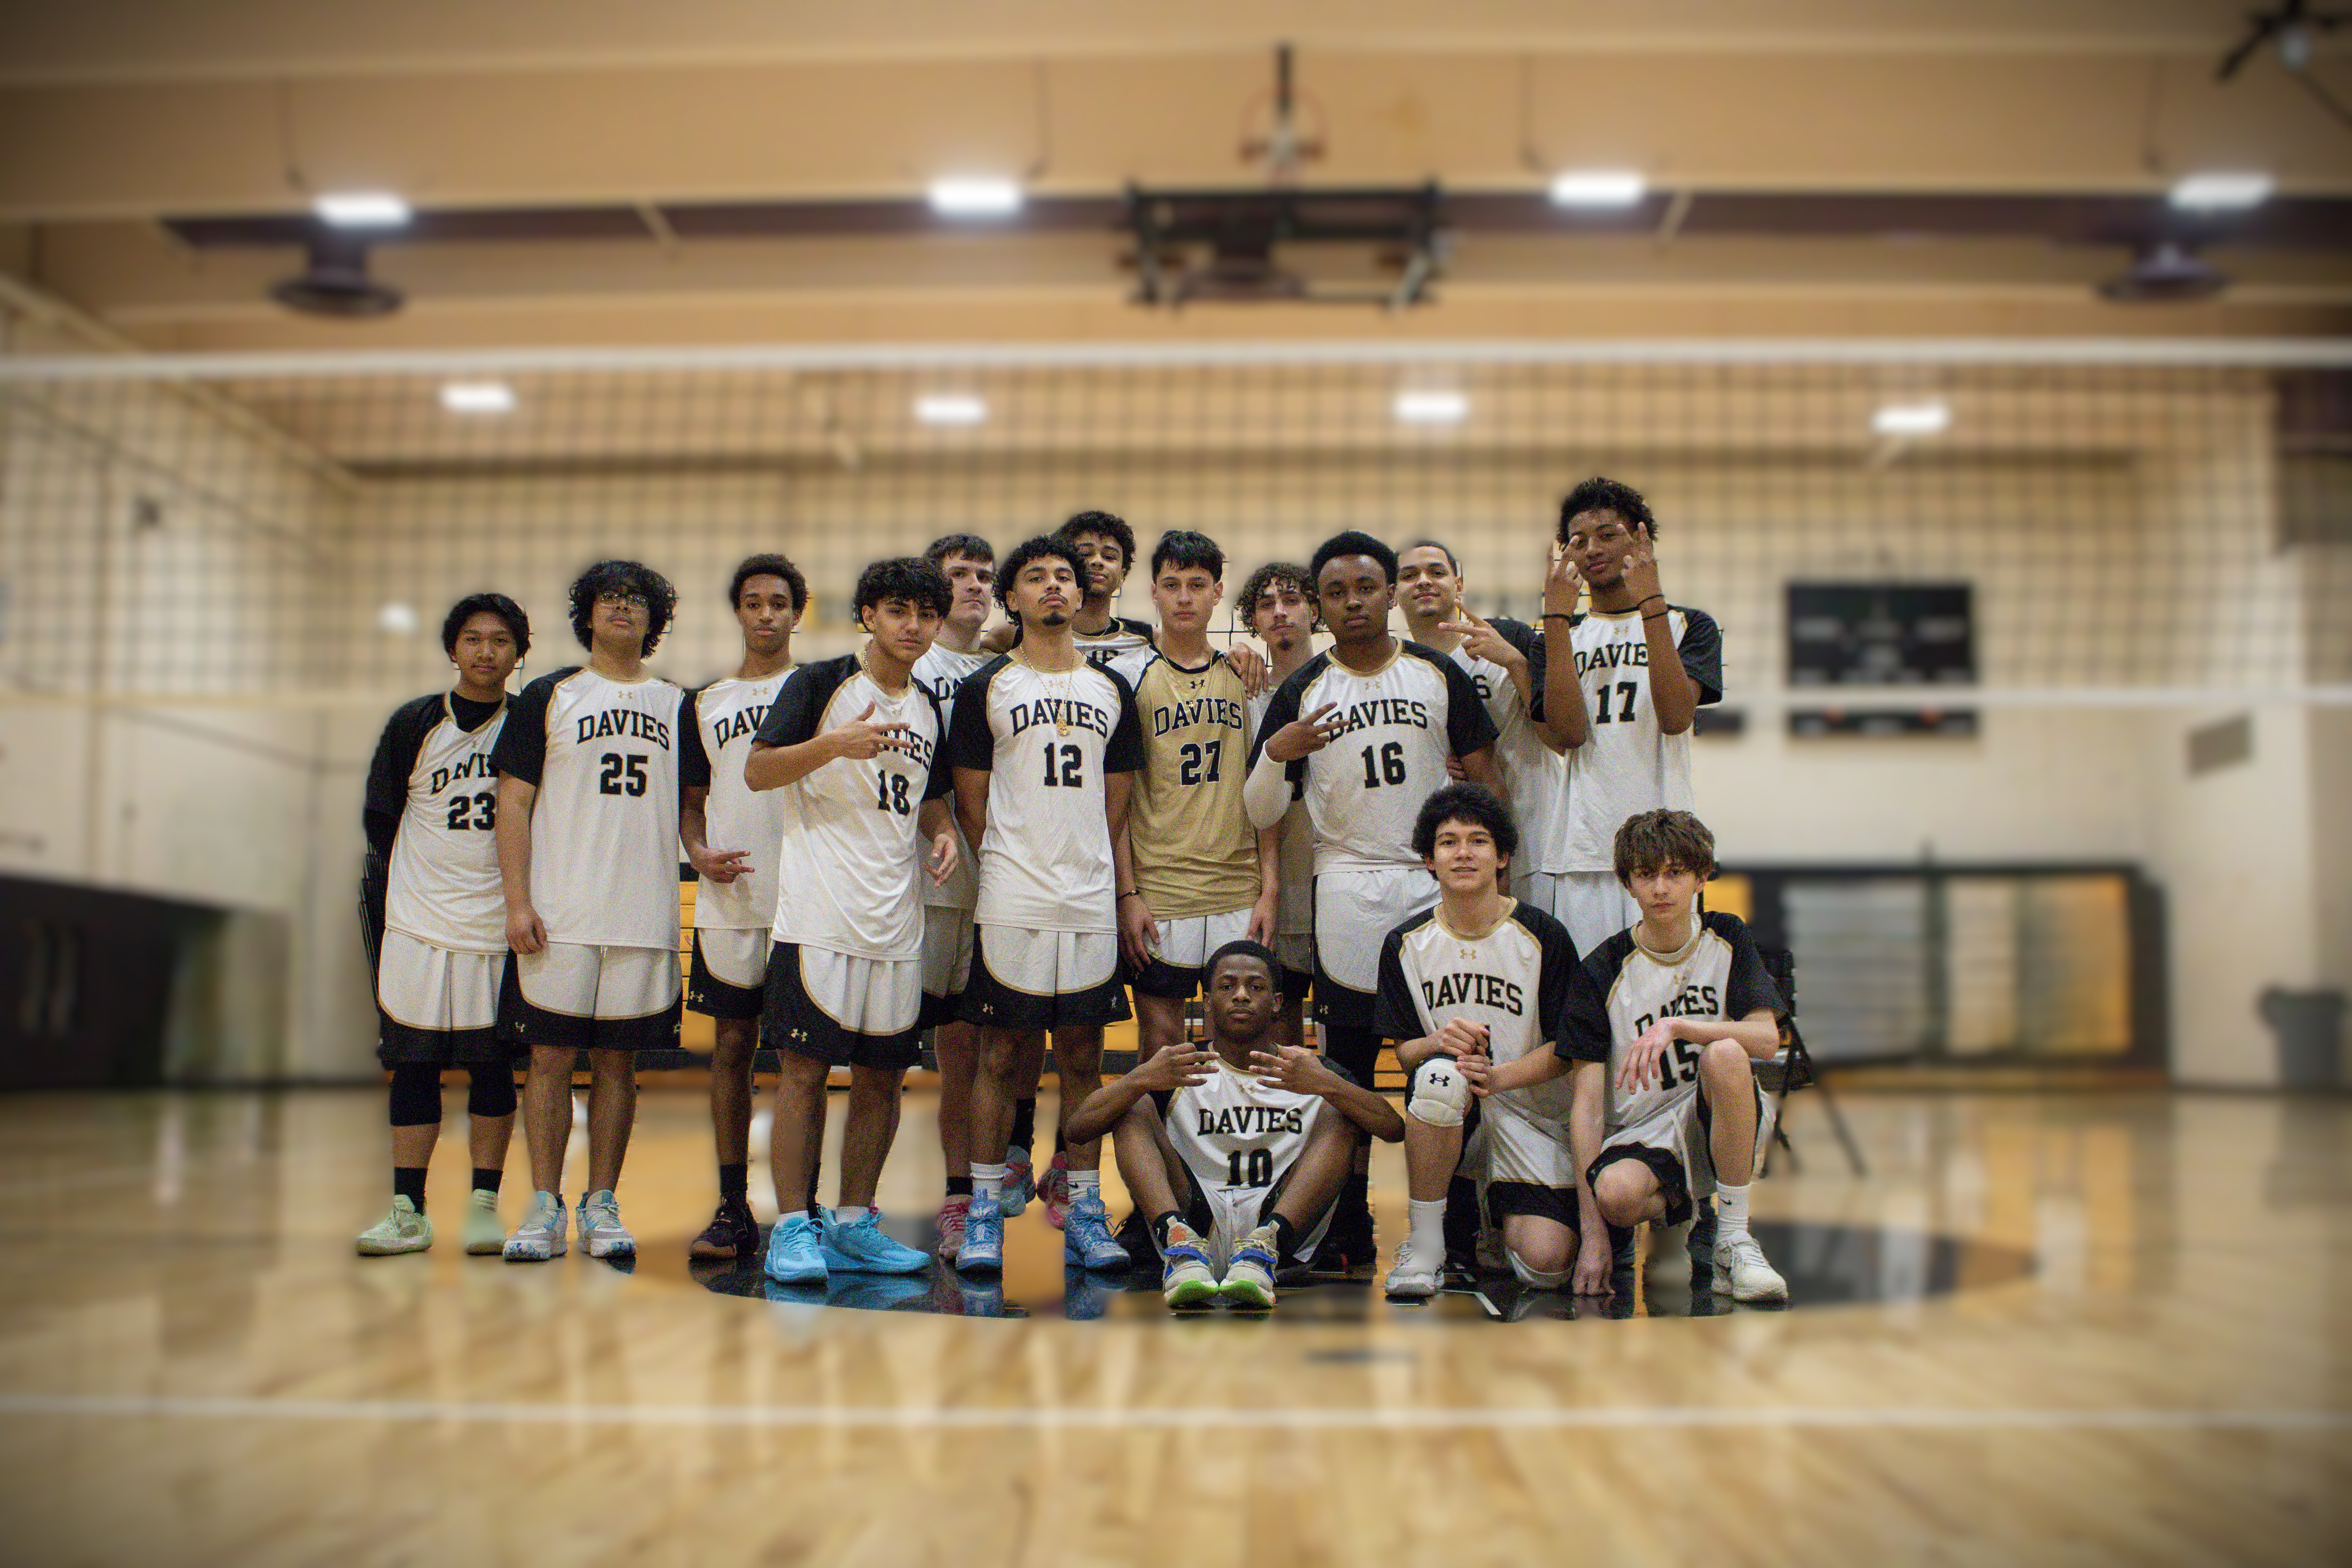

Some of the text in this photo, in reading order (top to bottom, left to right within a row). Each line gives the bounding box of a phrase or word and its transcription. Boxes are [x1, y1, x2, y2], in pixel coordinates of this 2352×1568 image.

[1574, 642, 1648, 679] DAVIE
[1010, 698, 1108, 739] DAVIES
[1154, 697, 1242, 738] DAVIES
[1326, 698, 1428, 744] DAVIES
[1596, 681, 1637, 724] 17
[577, 709, 670, 751] DAVIES
[714, 705, 773, 750] DAV
[600, 753, 649, 798] 25
[1044, 743, 1082, 788] 12
[1180, 740, 1221, 786] 27
[1361, 742, 1406, 788] 16
[447, 792, 496, 830] 23
[877, 770, 911, 816] 18
[1421, 973, 1523, 1016] DAVIES
[1659, 1038, 1701, 1091] 15
[1197, 1106, 1302, 1136] DAVIES
[1225, 1148, 1273, 1188] 10
